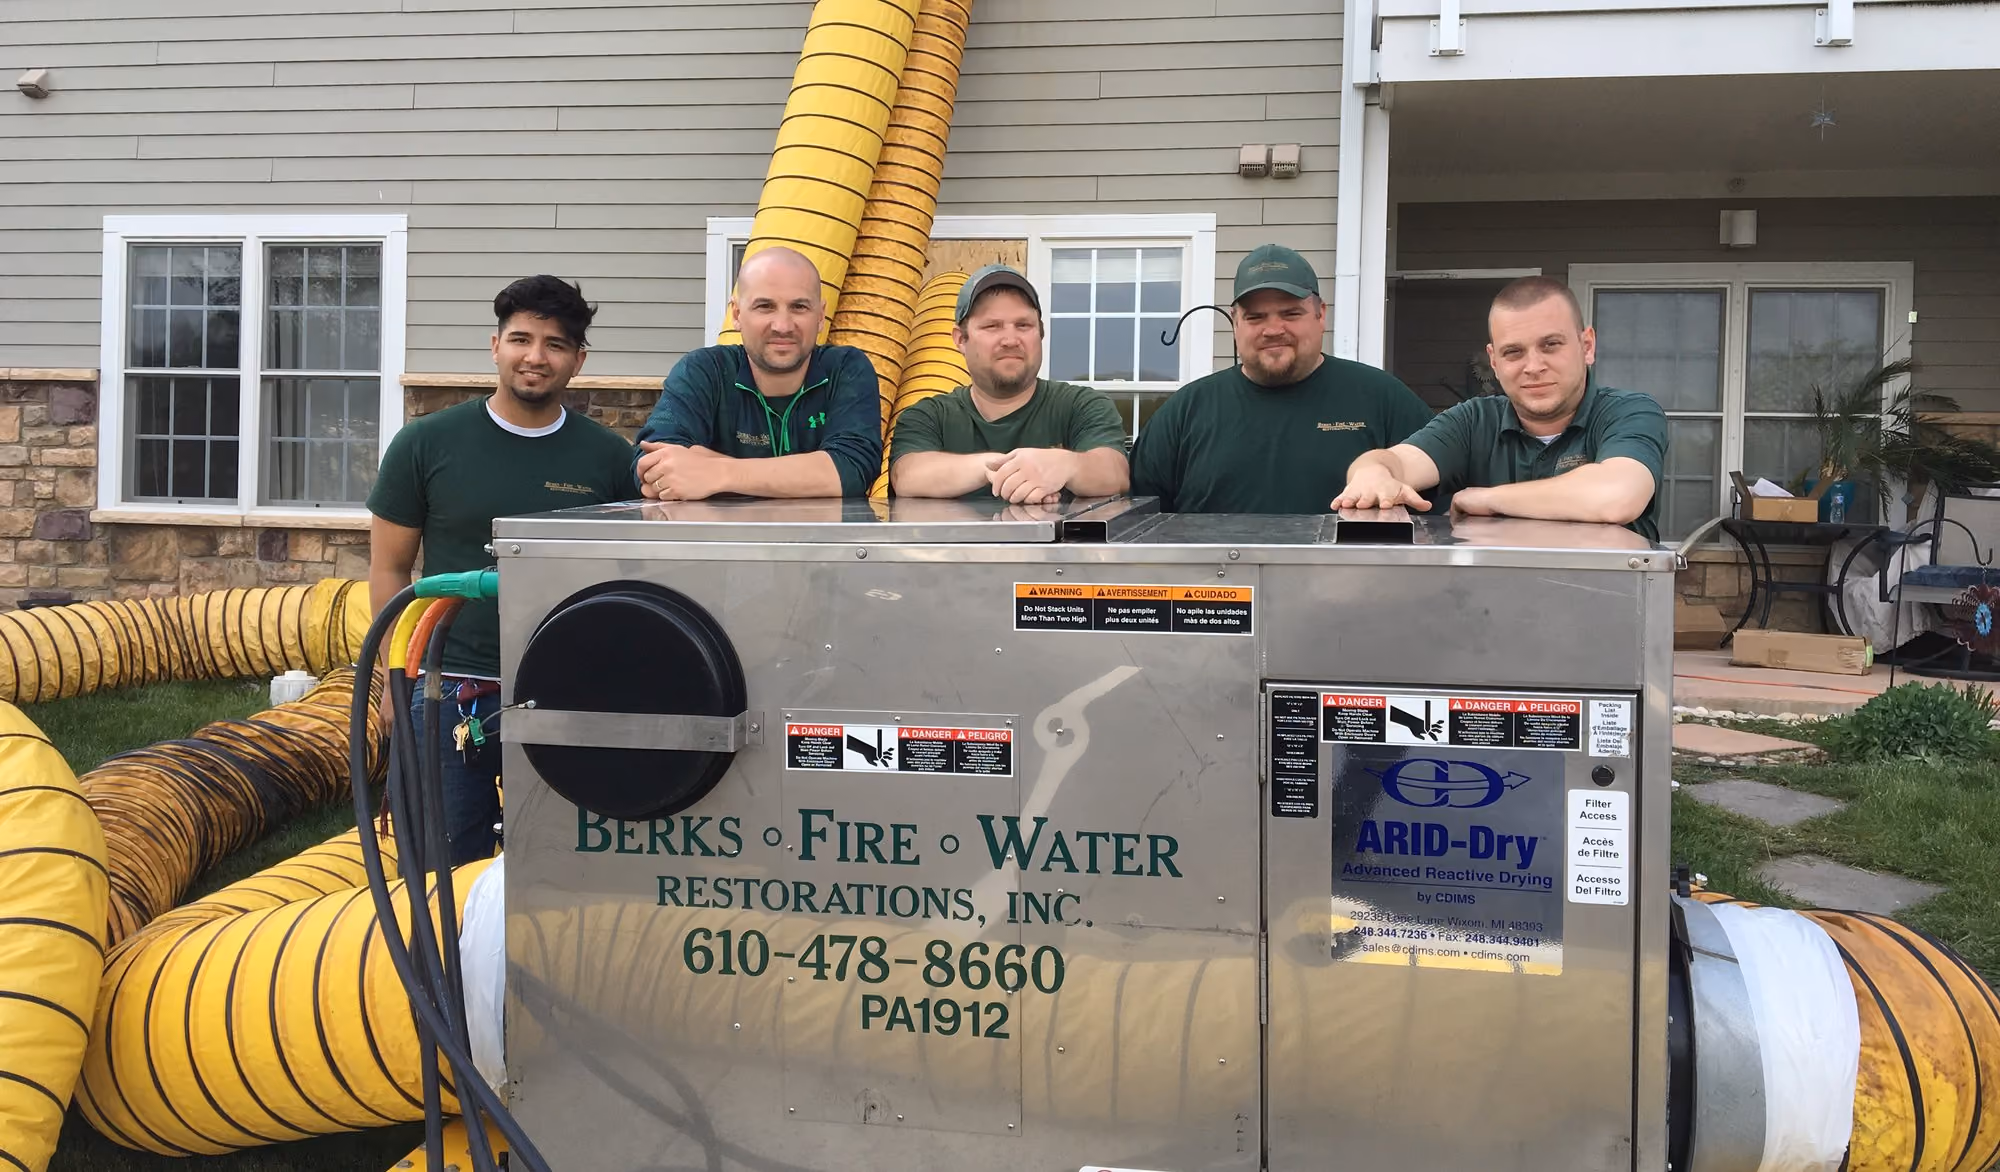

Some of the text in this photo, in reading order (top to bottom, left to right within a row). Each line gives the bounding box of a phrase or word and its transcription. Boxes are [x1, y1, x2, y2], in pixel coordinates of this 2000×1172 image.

[1039, 587, 1083, 596] WARNING
[1107, 589, 1168, 598] AVERTISSEMENT
[1194, 590, 1237, 599] CUIDADO
[1188, 608, 1204, 616] apile
[1217, 608, 1248, 616] unidades
[1072, 615, 1087, 624] High
[1105, 616, 1120, 625] plus
[1121, 616, 1138, 624] deux
[1199, 617, 1208, 625] de
[1209, 617, 1222, 625] dos
[1224, 617, 1240, 625] altos
[1339, 697, 1383, 707] DANGER
[1465, 701, 1511, 711] DANGER
[1530, 703, 1577, 713] PELIGRO
[801, 727, 841, 736] DANGER
[912, 730, 952, 739] DANGER
[968, 732, 1009, 741] PELIGRO
[1585, 799, 1612, 809] Filter
[1579, 811, 1617, 821] Access
[574, 806, 1184, 878] BERKS FIRE WATER
[1355, 820, 1539, 870] ARID-Dry
[1582, 837, 1615, 847] Accès
[1578, 849, 1620, 859] de Filtre
[1342, 862, 1553, 889] Advanced Reactive Drying
[1576, 874, 1621, 885] Accesso
[1575, 886, 1622, 897] Del Filtro
[656, 875, 1094, 929] RESTORATIONS, INC.
[1417, 891, 1476, 905] by CDIMS
[1491, 919, 1505, 930] MI
[1508, 921, 1544, 933] 48393
[1354, 926, 1540, 948] 248.344.7236 Fax: 248.344.9401
[1362, 943, 1530, 963] sales@cdims.com cdims.com
[683, 927, 1066, 995] 610-478-8660
[861, 994, 1010, 1040] PA1912
